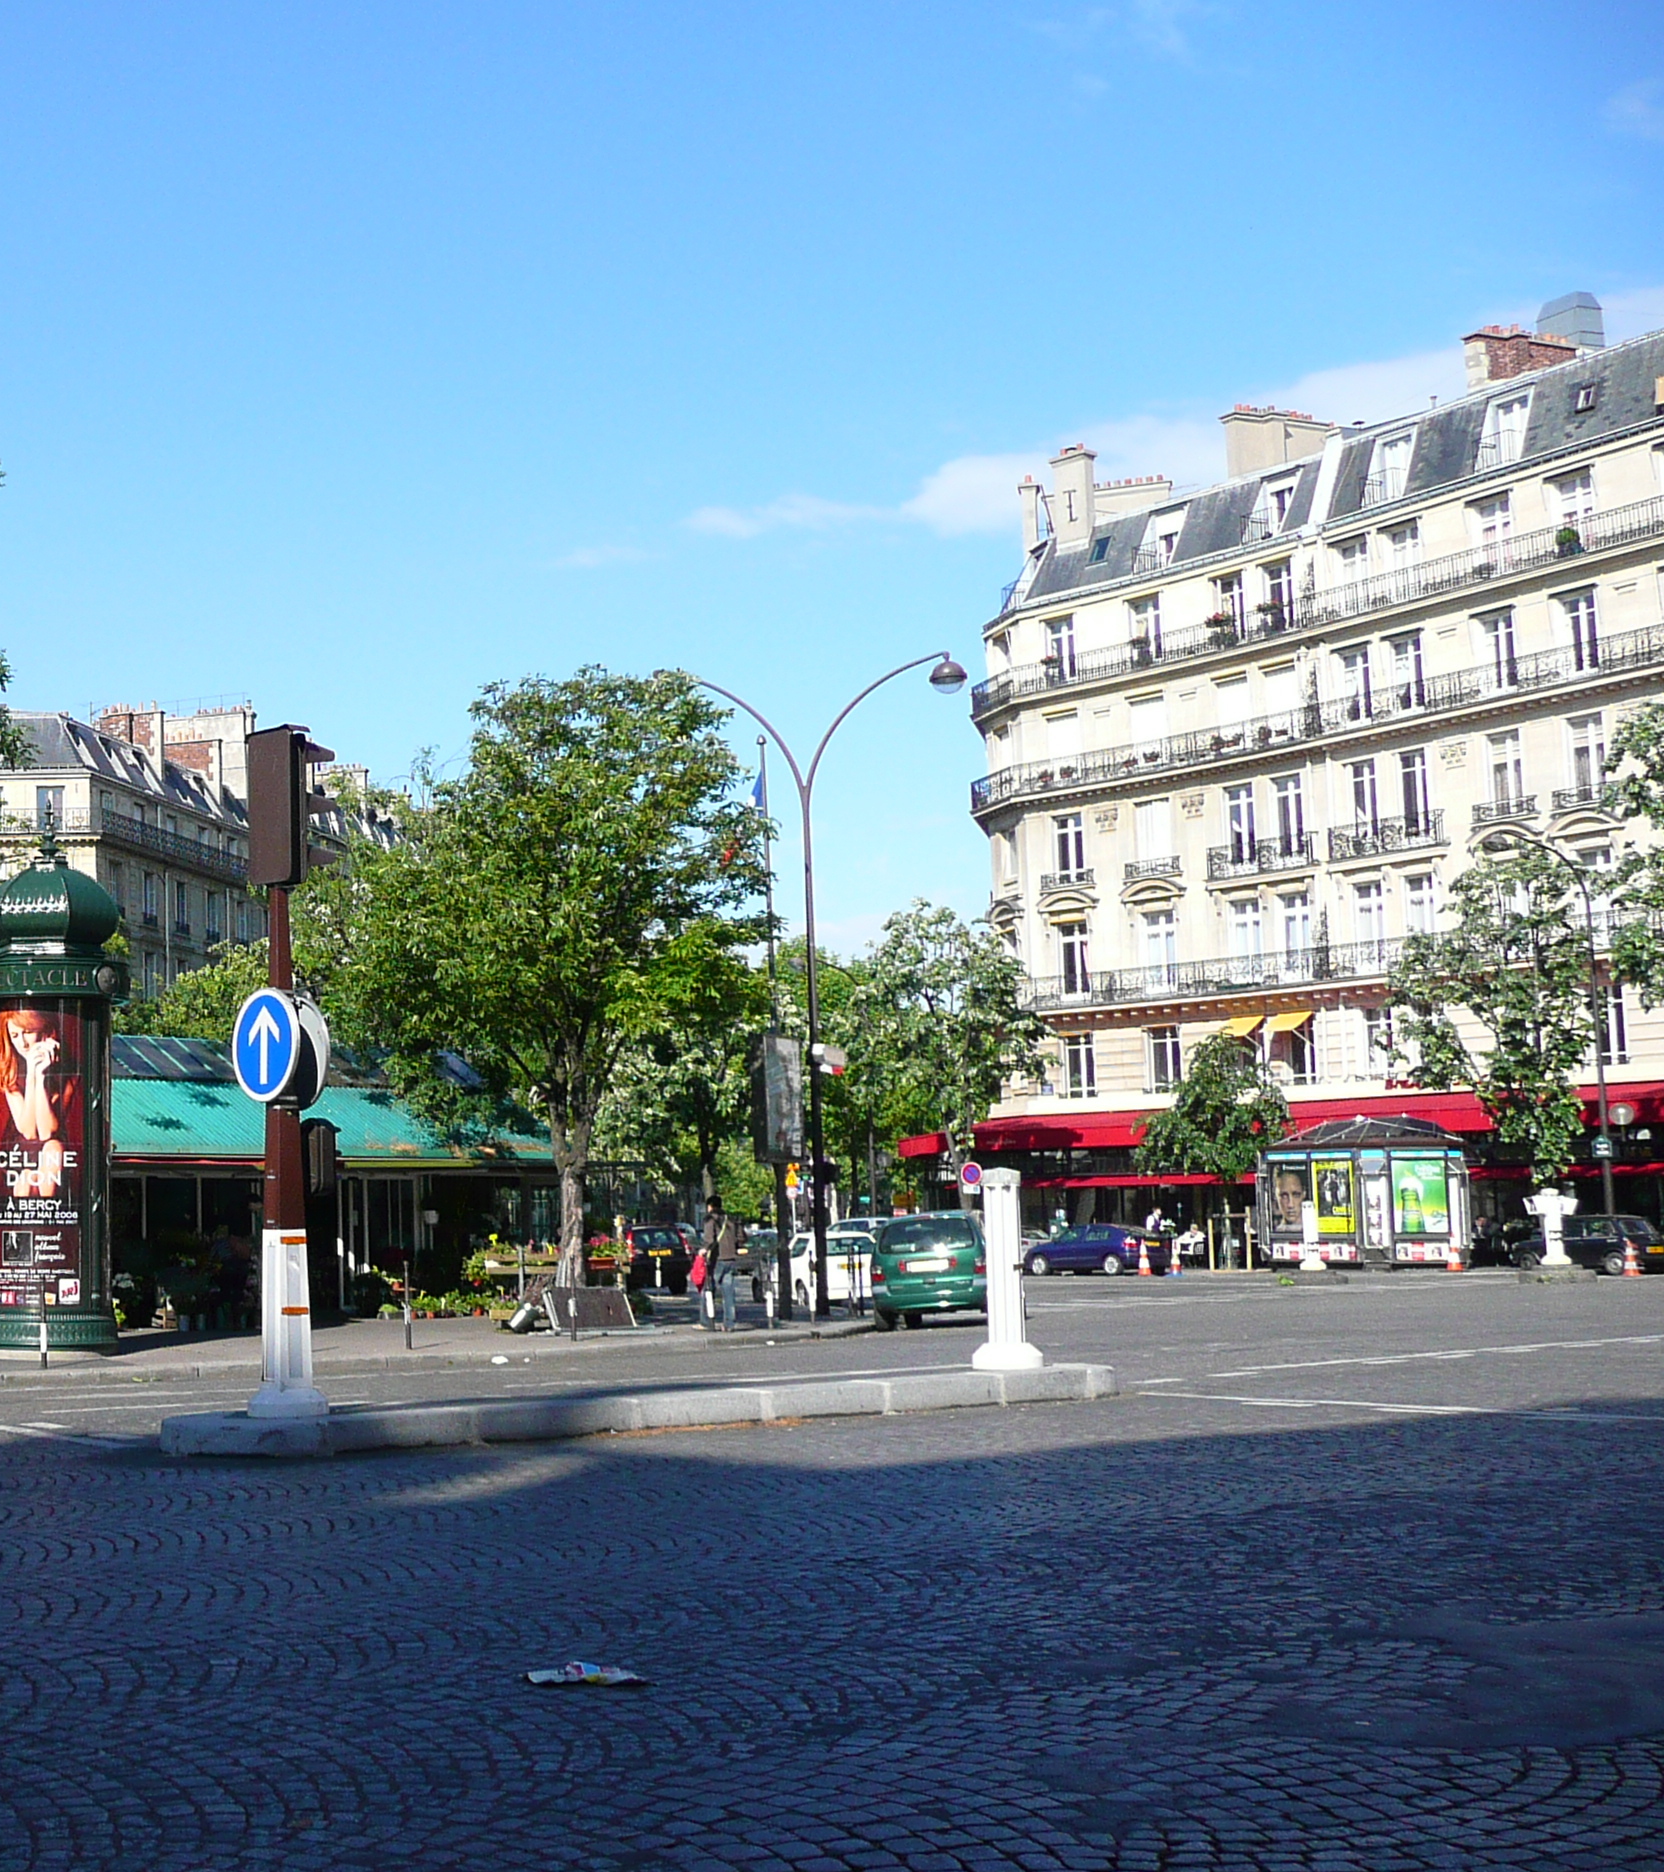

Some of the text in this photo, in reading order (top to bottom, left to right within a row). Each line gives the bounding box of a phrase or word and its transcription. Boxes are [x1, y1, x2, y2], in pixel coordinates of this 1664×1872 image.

[6, 1169, 62, 1187] DION
[6, 1195, 63, 1211] À BERCY
[24, 1211, 36, 1219] 27
[37, 1211, 53, 1219] MAI
